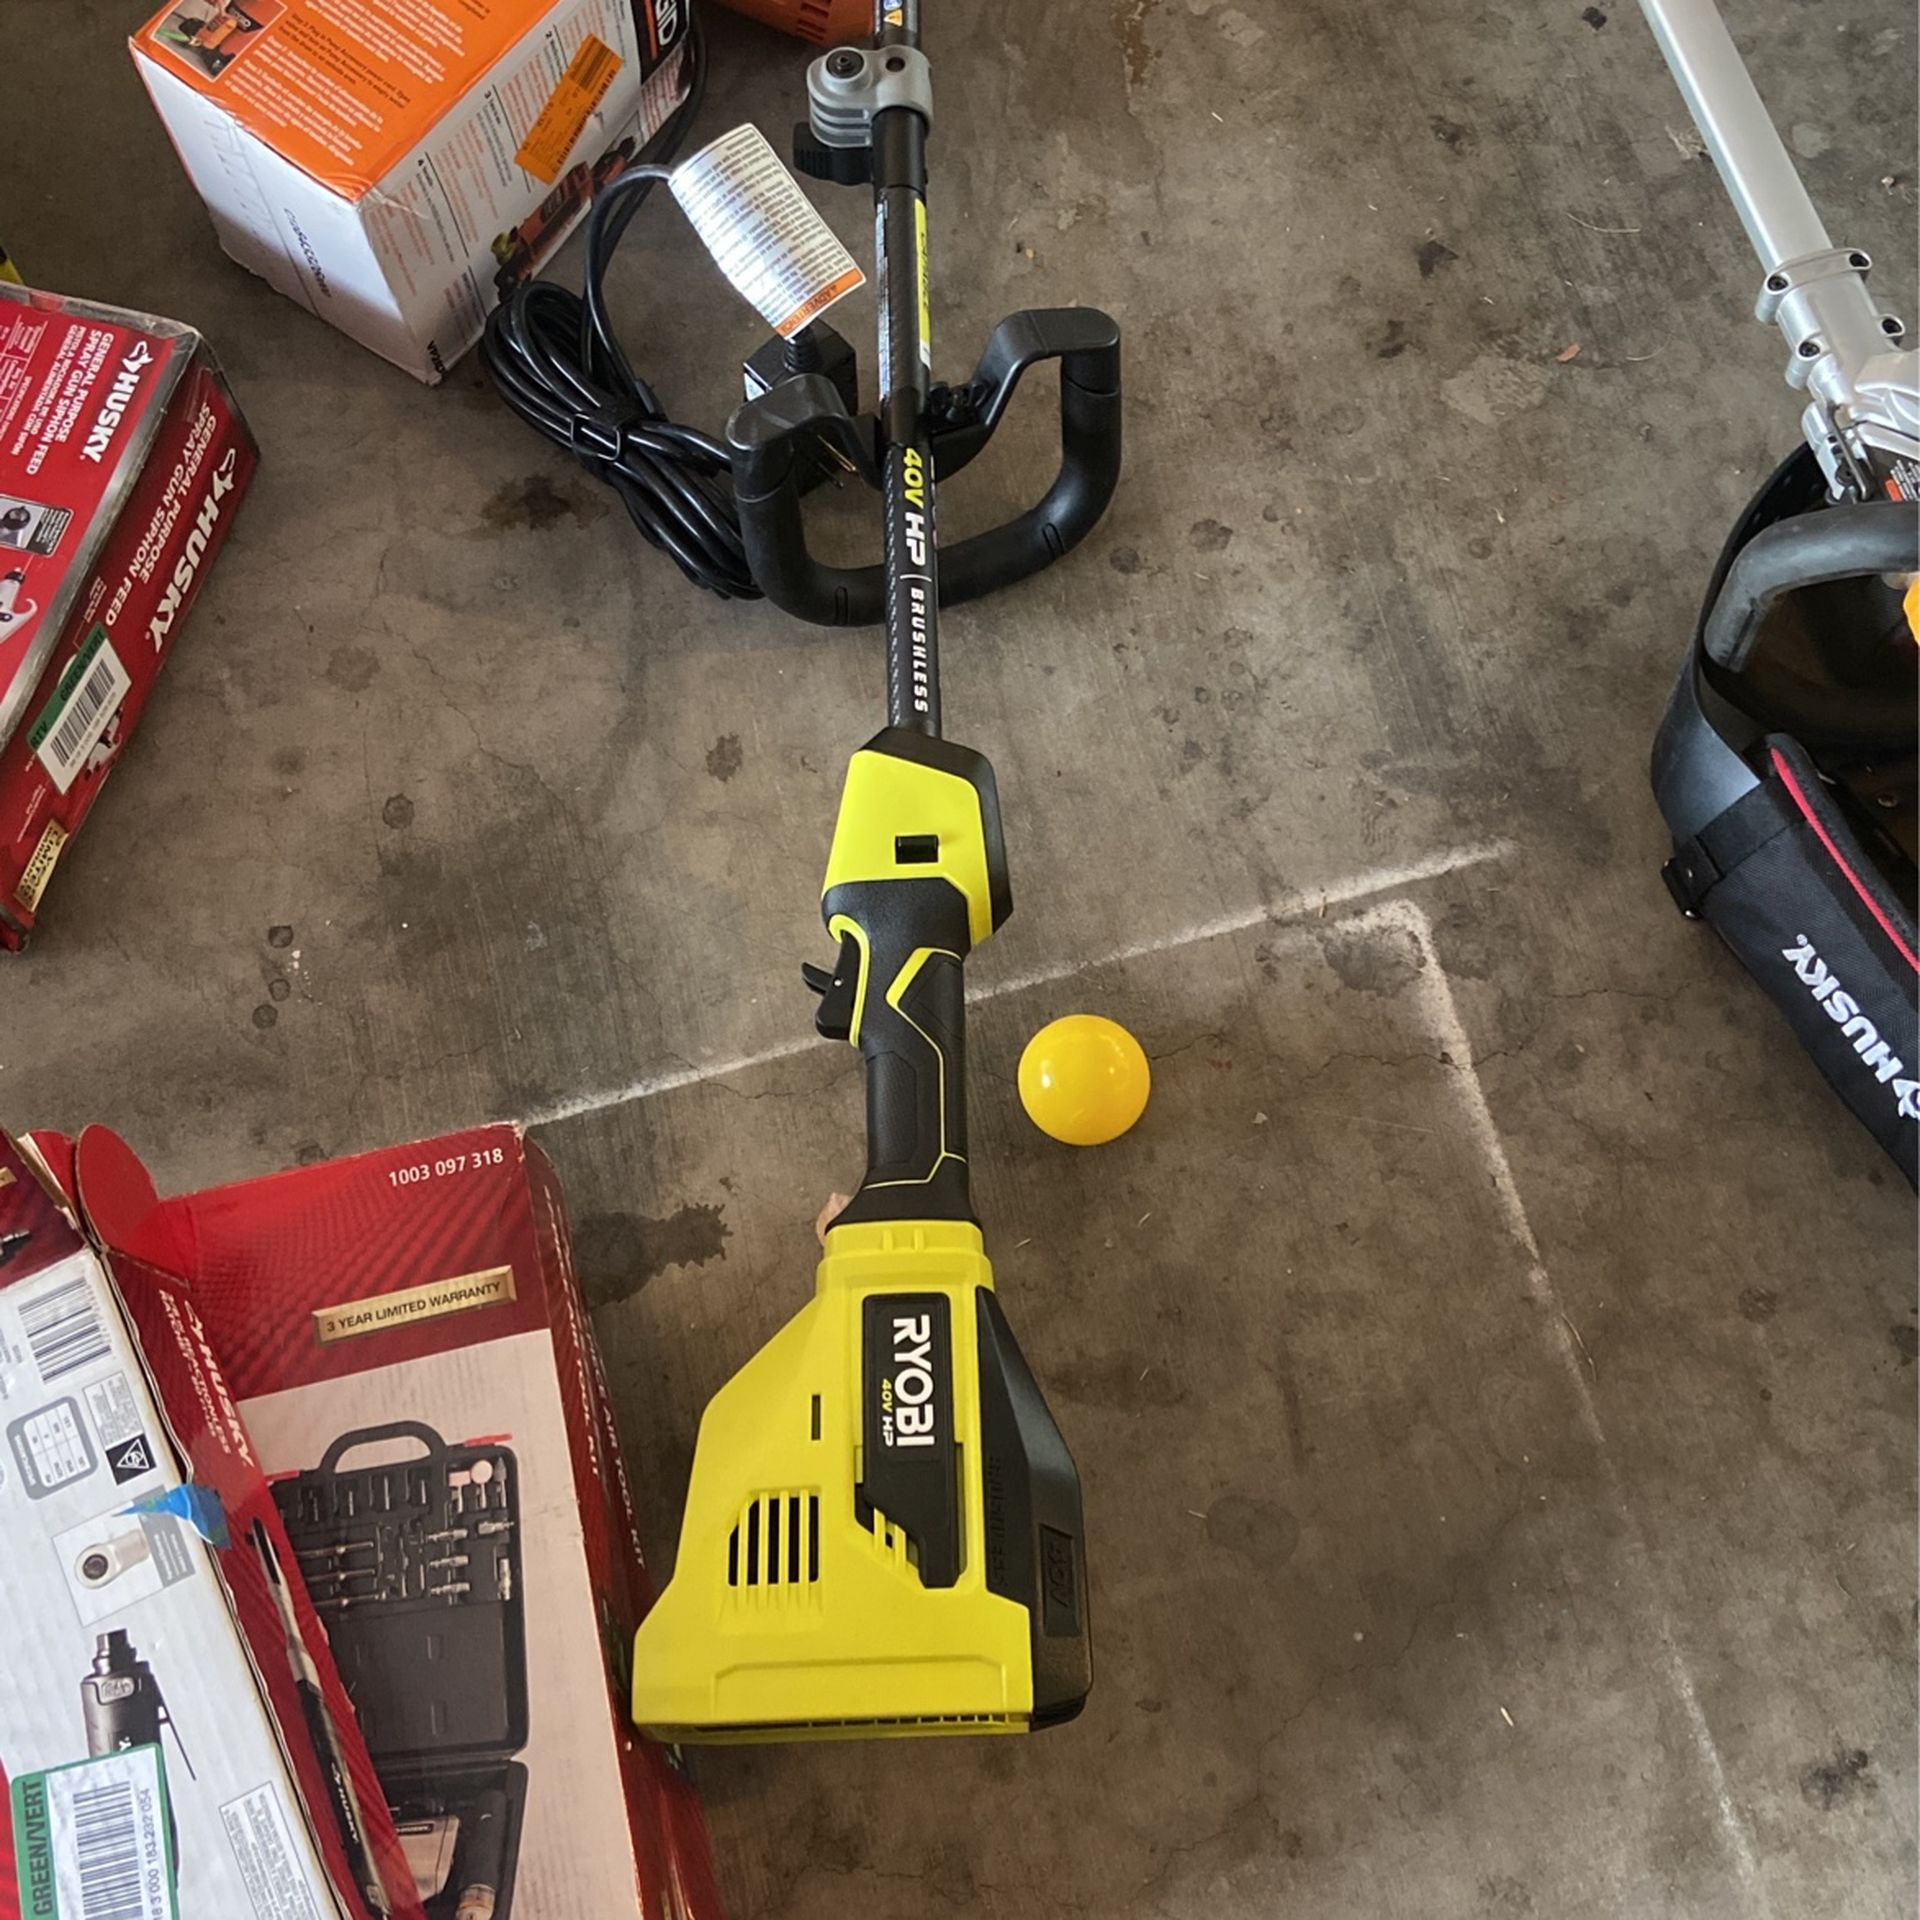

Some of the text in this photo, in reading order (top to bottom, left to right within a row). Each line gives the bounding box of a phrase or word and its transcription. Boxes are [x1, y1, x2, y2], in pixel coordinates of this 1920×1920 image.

[24, 328, 101, 475] SPRAY GUN SIPHON FEED
[54, 331, 113, 443] GENERAL PURPOSE
[81, 368, 139, 462] HUSKY
[103, 401, 210, 627] SPRAY GUN SIPHON FEED
[138, 413, 216, 583] GENERAL PURPOSE
[146, 494, 220, 652] HUSKY
[902, 447, 929, 716] 40V HP BRUSHLESS
[1780, 942, 1904, 1084] HUSKY
[388, 1147, 504, 1187] 1003 097 318
[327, 1281, 501, 1332] 3 YEAR LIMITED WARRANTY
[182, 1336, 231, 1452] REACTIONLESS
[198, 1343, 254, 1467] HUSKY
[577, 1359, 590, 1426] TOOL
[587, 1435, 599, 1477] KIT
[881, 1378, 893, 1447] 40V HP
[893, 1314, 935, 1448] RYOBI
[603, 1406, 618, 1449] AIR
[615, 1457, 632, 1520] TOOL
[629, 1527, 645, 1569] KIT
[22, 1780, 52, 1914] GREEN/VERT
[140, 1788, 154, 1813] 054
[149, 1868, 160, 1893] 000
